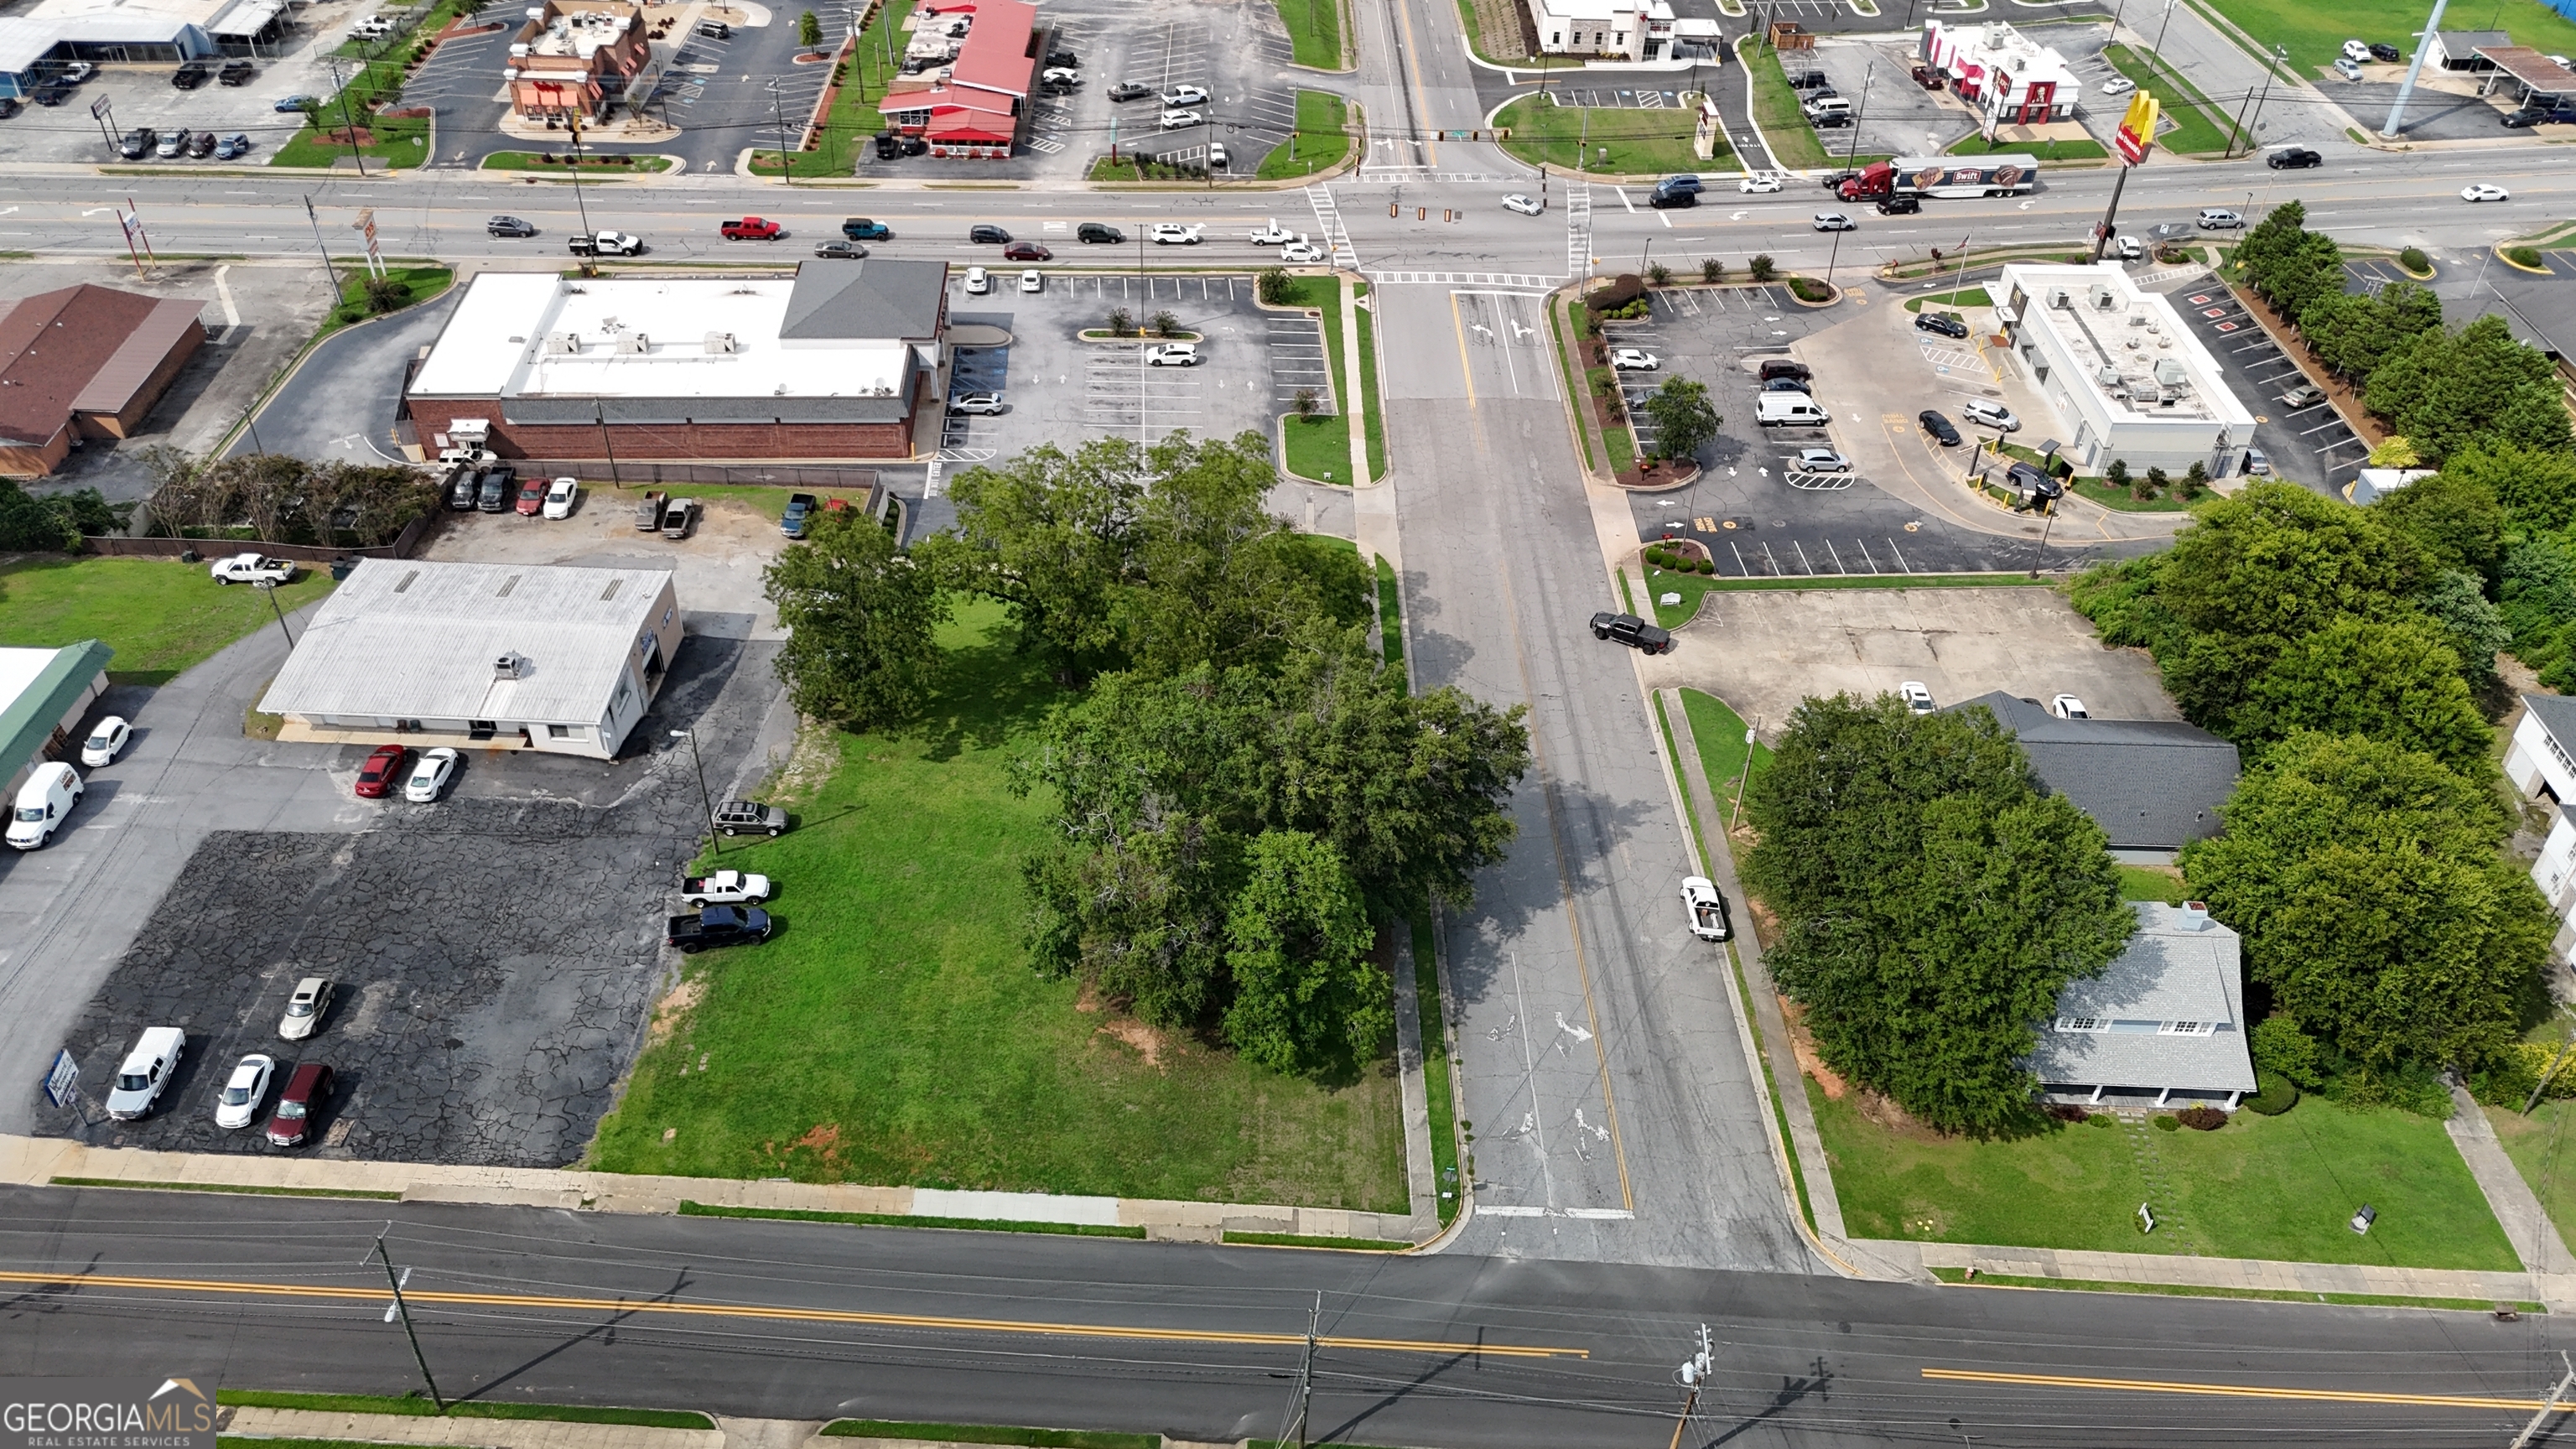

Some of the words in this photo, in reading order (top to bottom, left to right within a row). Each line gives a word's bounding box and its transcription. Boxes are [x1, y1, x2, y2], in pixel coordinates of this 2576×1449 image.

[1955, 172, 1978, 180] Swift
[932, 462, 943, 477] ENTER
[1693, 517, 1706, 532] THRU
[1703, 517, 1718, 533] DRIVE
